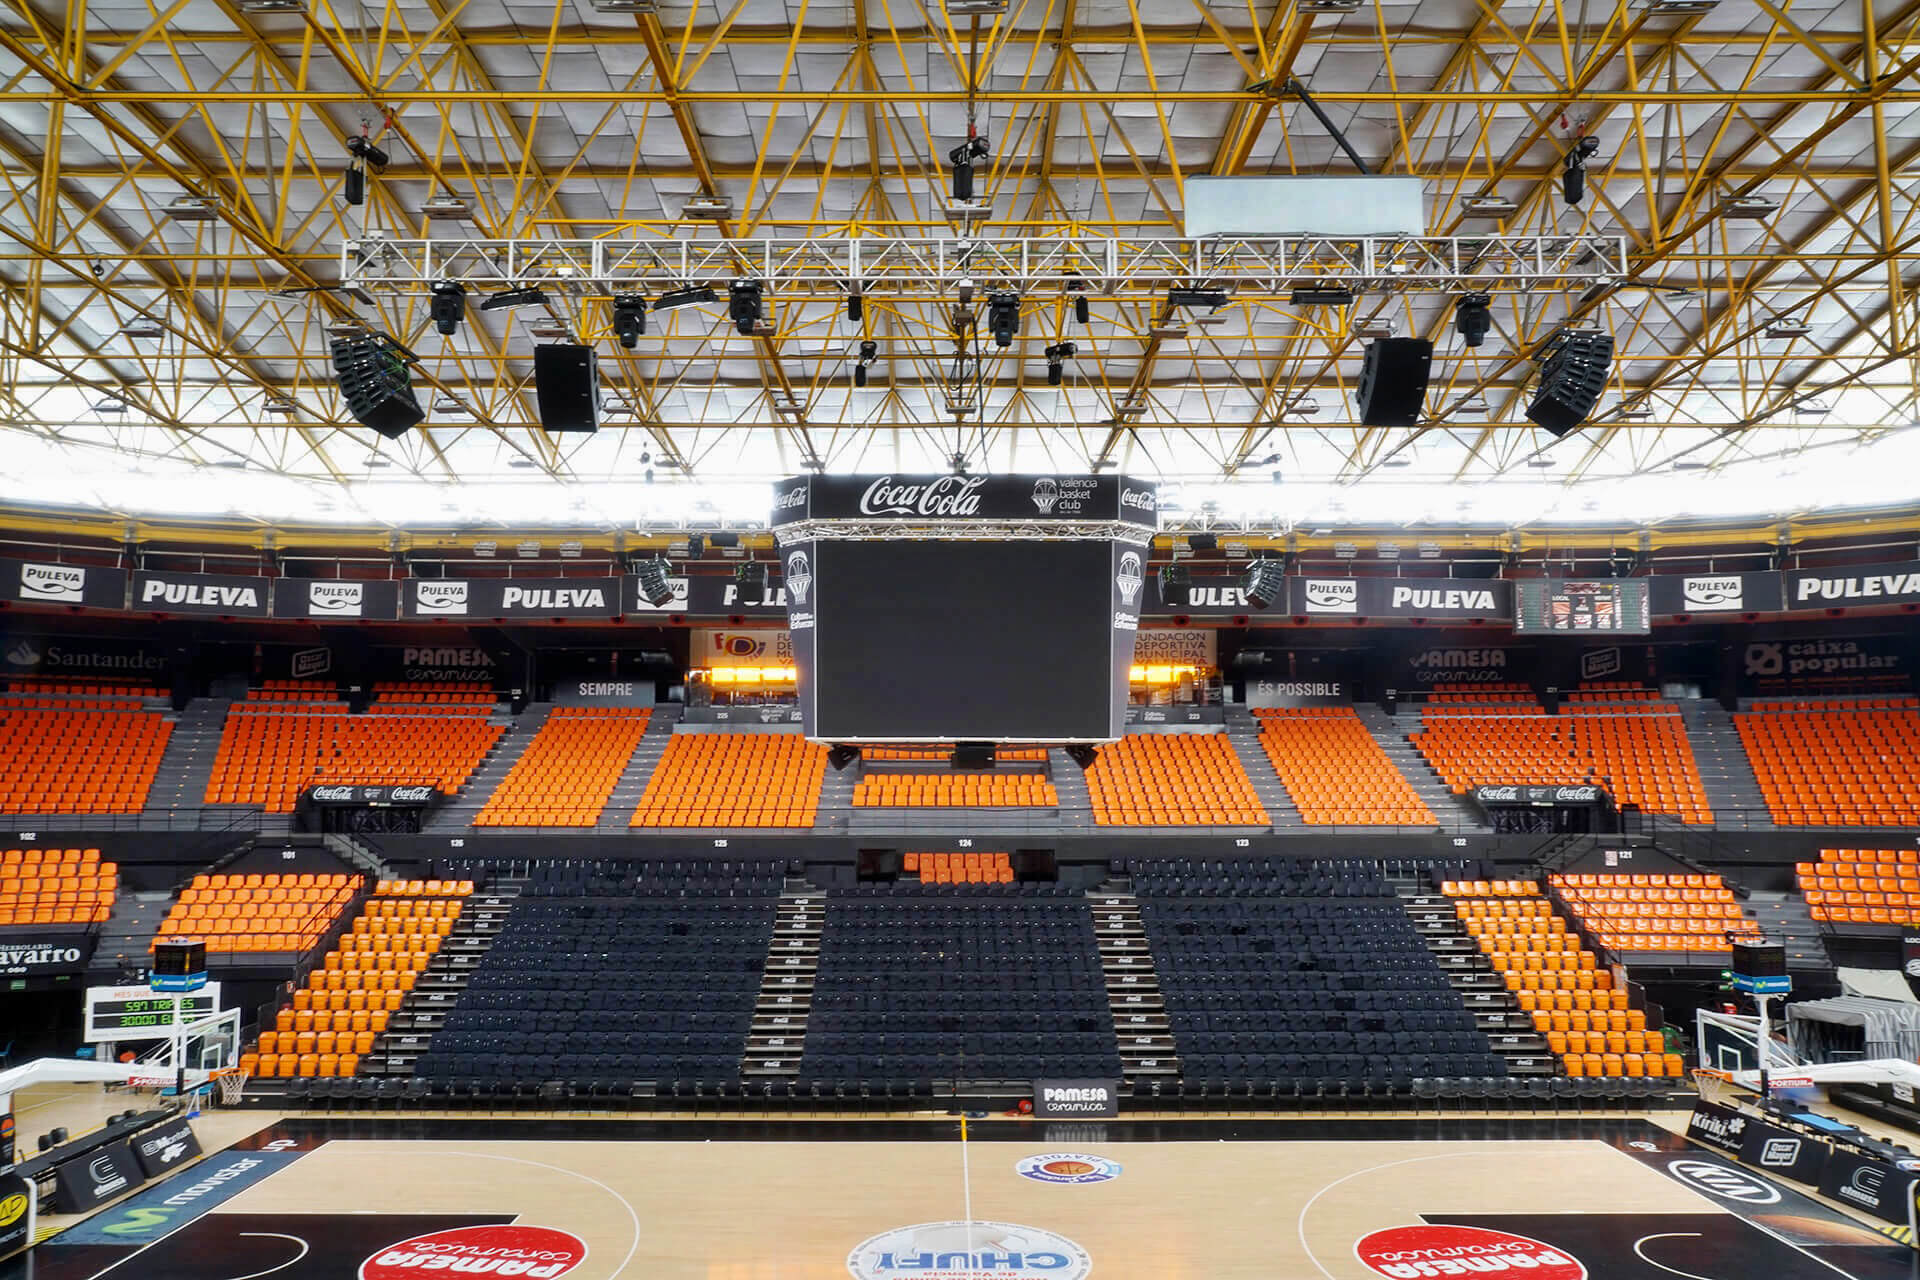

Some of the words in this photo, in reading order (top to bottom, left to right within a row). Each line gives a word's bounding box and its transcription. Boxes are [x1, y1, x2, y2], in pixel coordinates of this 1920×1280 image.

[1060, 478, 1098, 488] valencia
[860, 476, 987, 515] Coca-Cola
[1060, 488, 1091, 499] basket
[1060, 499, 1081, 510] club
[26, 569, 80, 582] PULEVA
[142, 580, 258, 607] PULEVA
[313, 586, 359, 598] PULEVA
[420, 585, 465, 597] PULEVA
[1309, 583, 1353, 595] PULEVA
[1687, 582, 1738, 592] PULEVA
[1797, 574, 1920, 600] PULEVA
[502, 587, 605, 608] PULEVA
[1392, 587, 1495, 609] PULEVA
[1134, 642, 1206, 650] DEPORTIVA
[1789, 640, 1858, 655] caixa
[47, 647, 168, 669] Santander
[1134, 650, 1207, 659] MUNICIPAL
[1789, 653, 1898, 673] popular
[579, 683, 633, 696] SEMPRE
[1258, 680, 1274, 696] ÉS
[1278, 683, 1341, 696] POSSIBLE
[125, 1001, 149, 1012] 597
[152, 999, 194, 1010] TRIPES
[120, 1015, 157, 1026] 30000
[1044, 1087, 1108, 1101] PAMESA
[1047, 1102, 1107, 1112] ceramica
[1692, 1112, 1729, 1136] Kiriki
[163, 1158, 264, 1205] movistar
[411, 1242, 572, 1261] ceramica
[1370, 1242, 1535, 1261] ceramica
[376, 1251, 568, 1279] PAMESA
[1379, 1251, 1572, 1279] PAMESA
